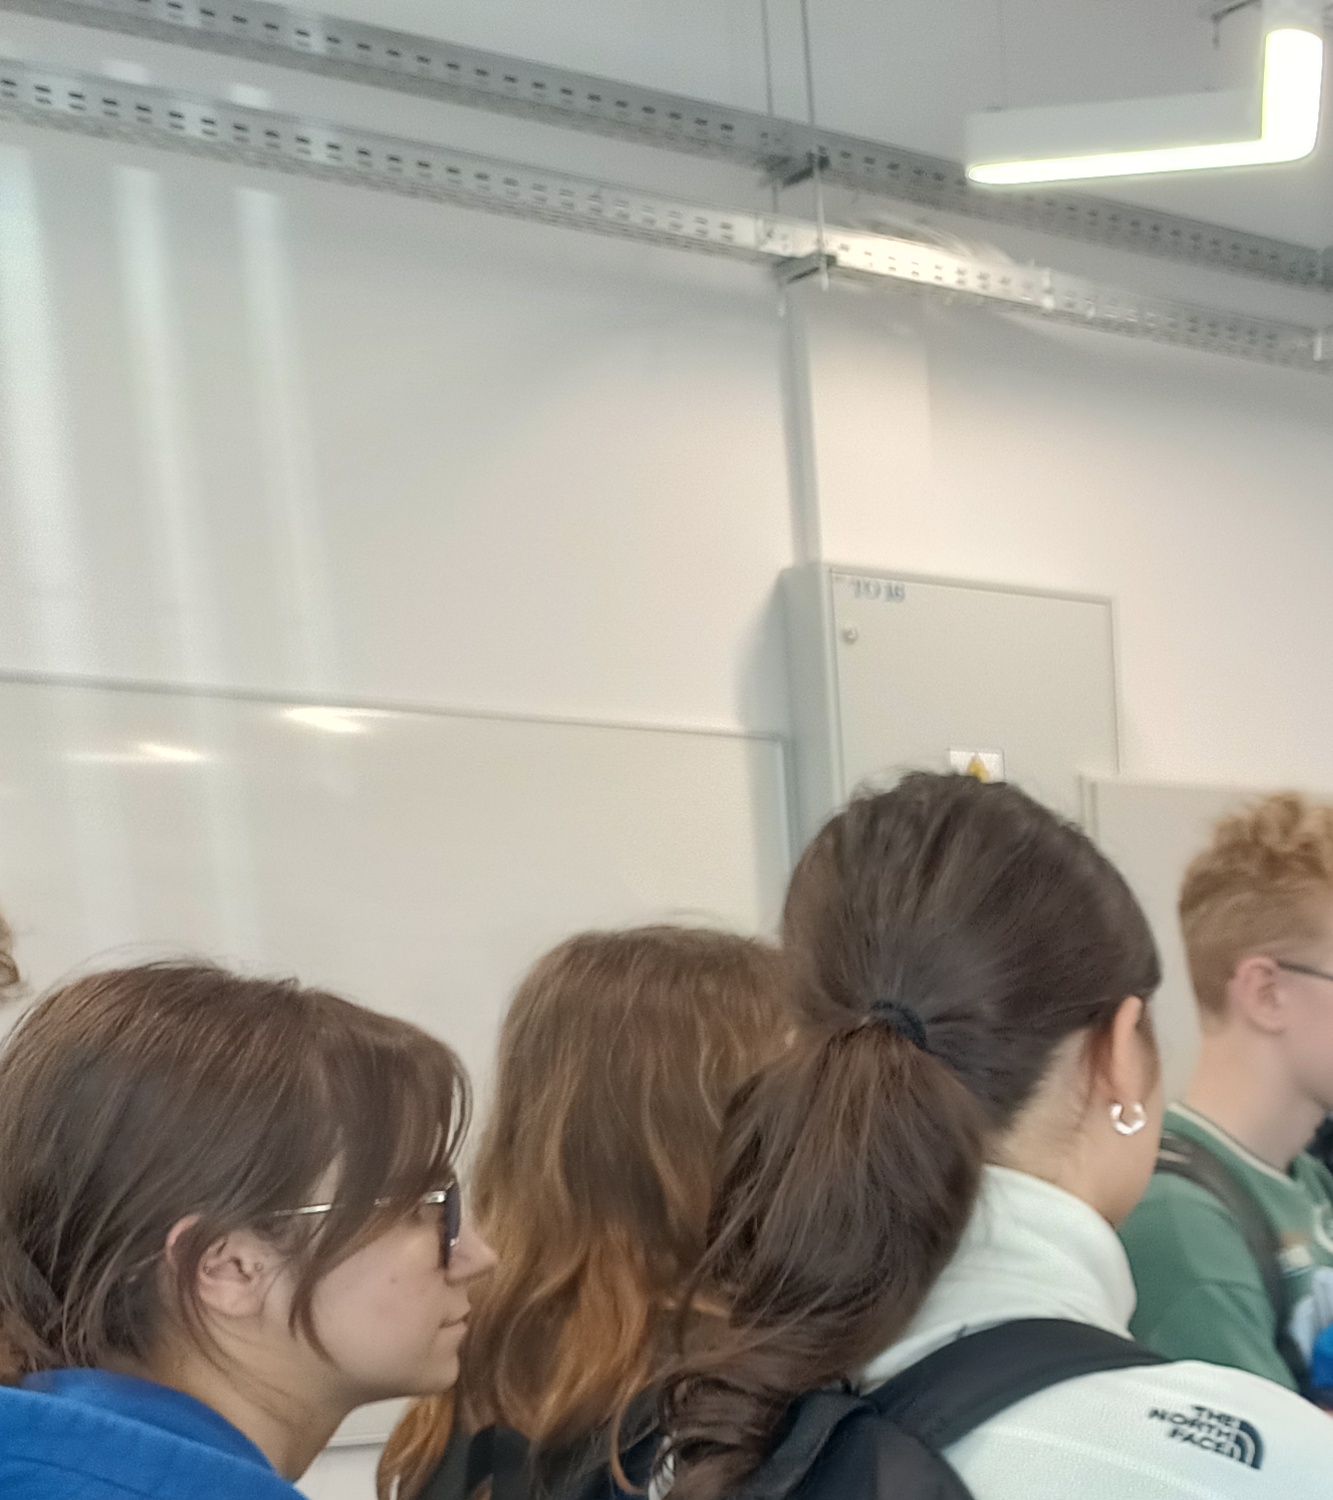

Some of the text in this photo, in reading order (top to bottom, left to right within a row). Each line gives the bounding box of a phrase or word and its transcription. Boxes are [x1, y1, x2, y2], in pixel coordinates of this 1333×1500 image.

[1148, 1408, 1232, 1439] NORTH
[1192, 1404, 1236, 1427] THE
[1168, 1427, 1231, 1456] FACE
